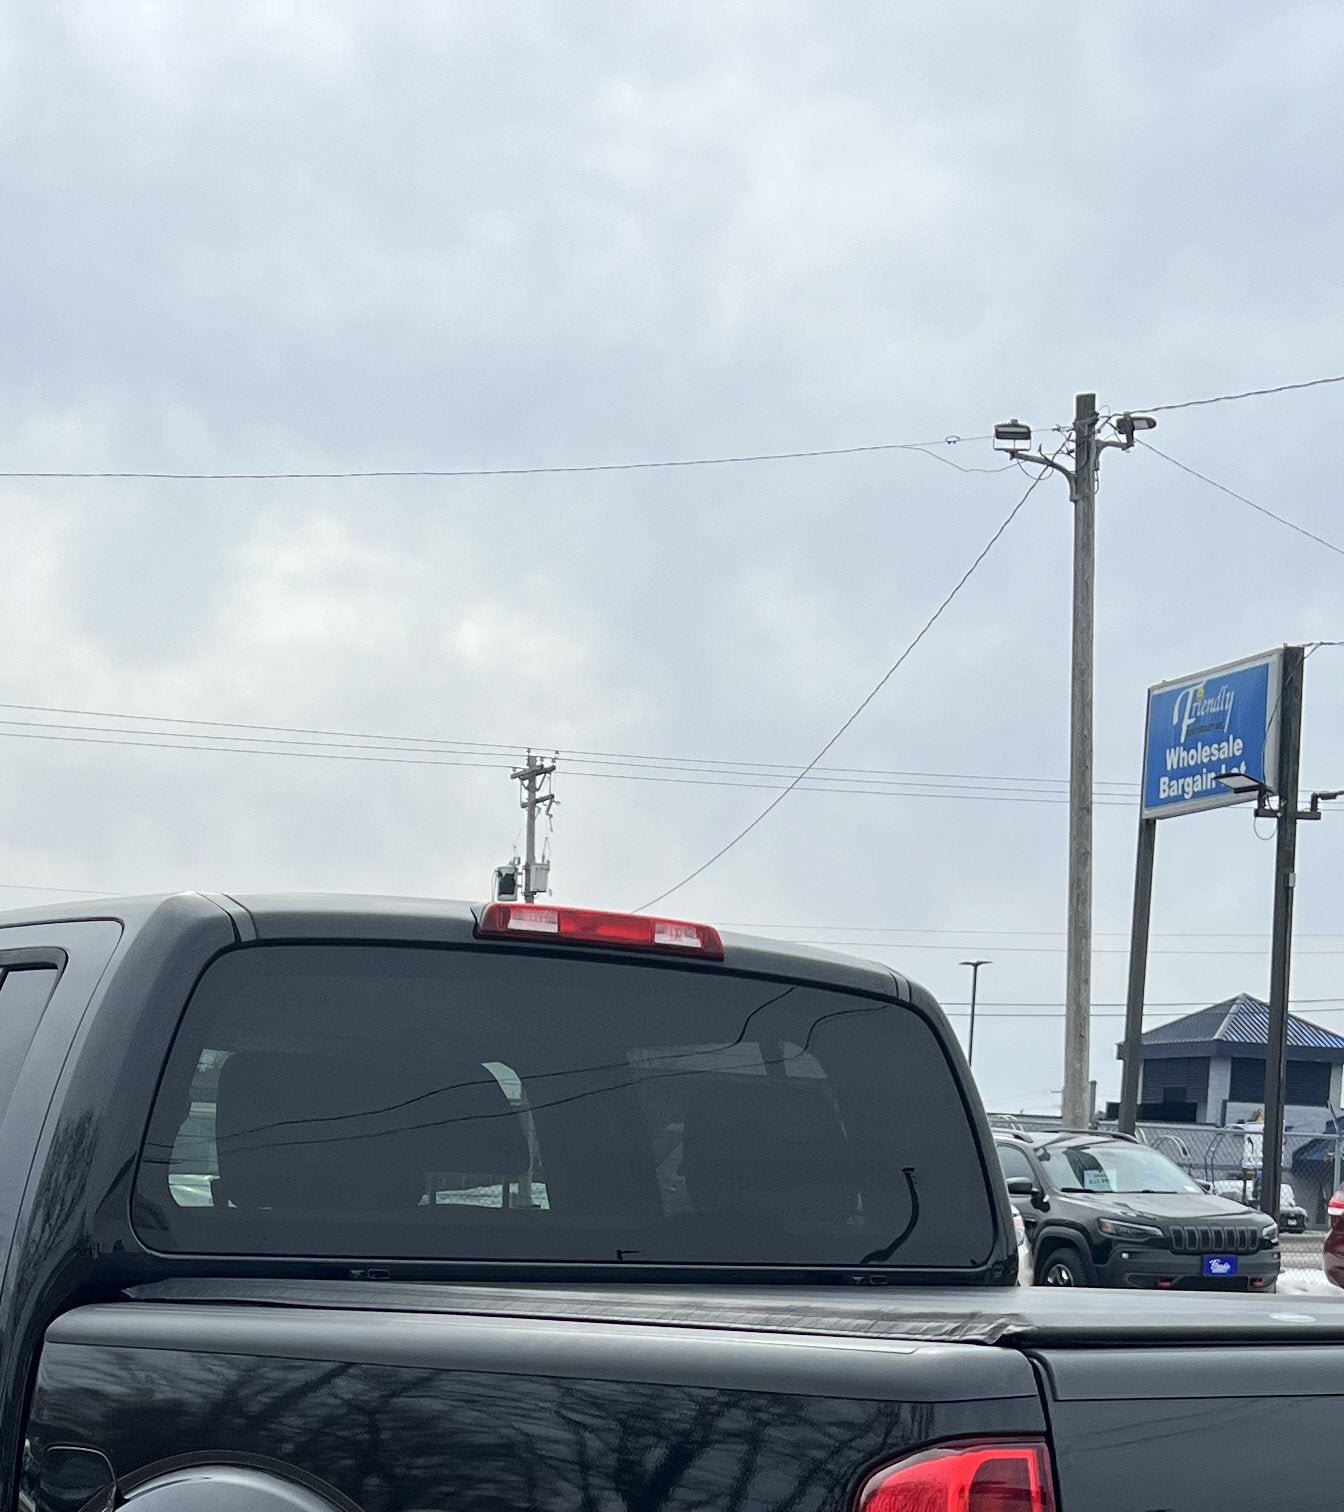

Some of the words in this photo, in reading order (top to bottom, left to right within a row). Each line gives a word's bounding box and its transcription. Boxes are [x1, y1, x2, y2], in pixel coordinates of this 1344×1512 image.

[1173, 681, 1235, 743] Friendly
[1166, 734, 1244, 771] Wholesale
[1159, 768, 1217, 799] Bargain
